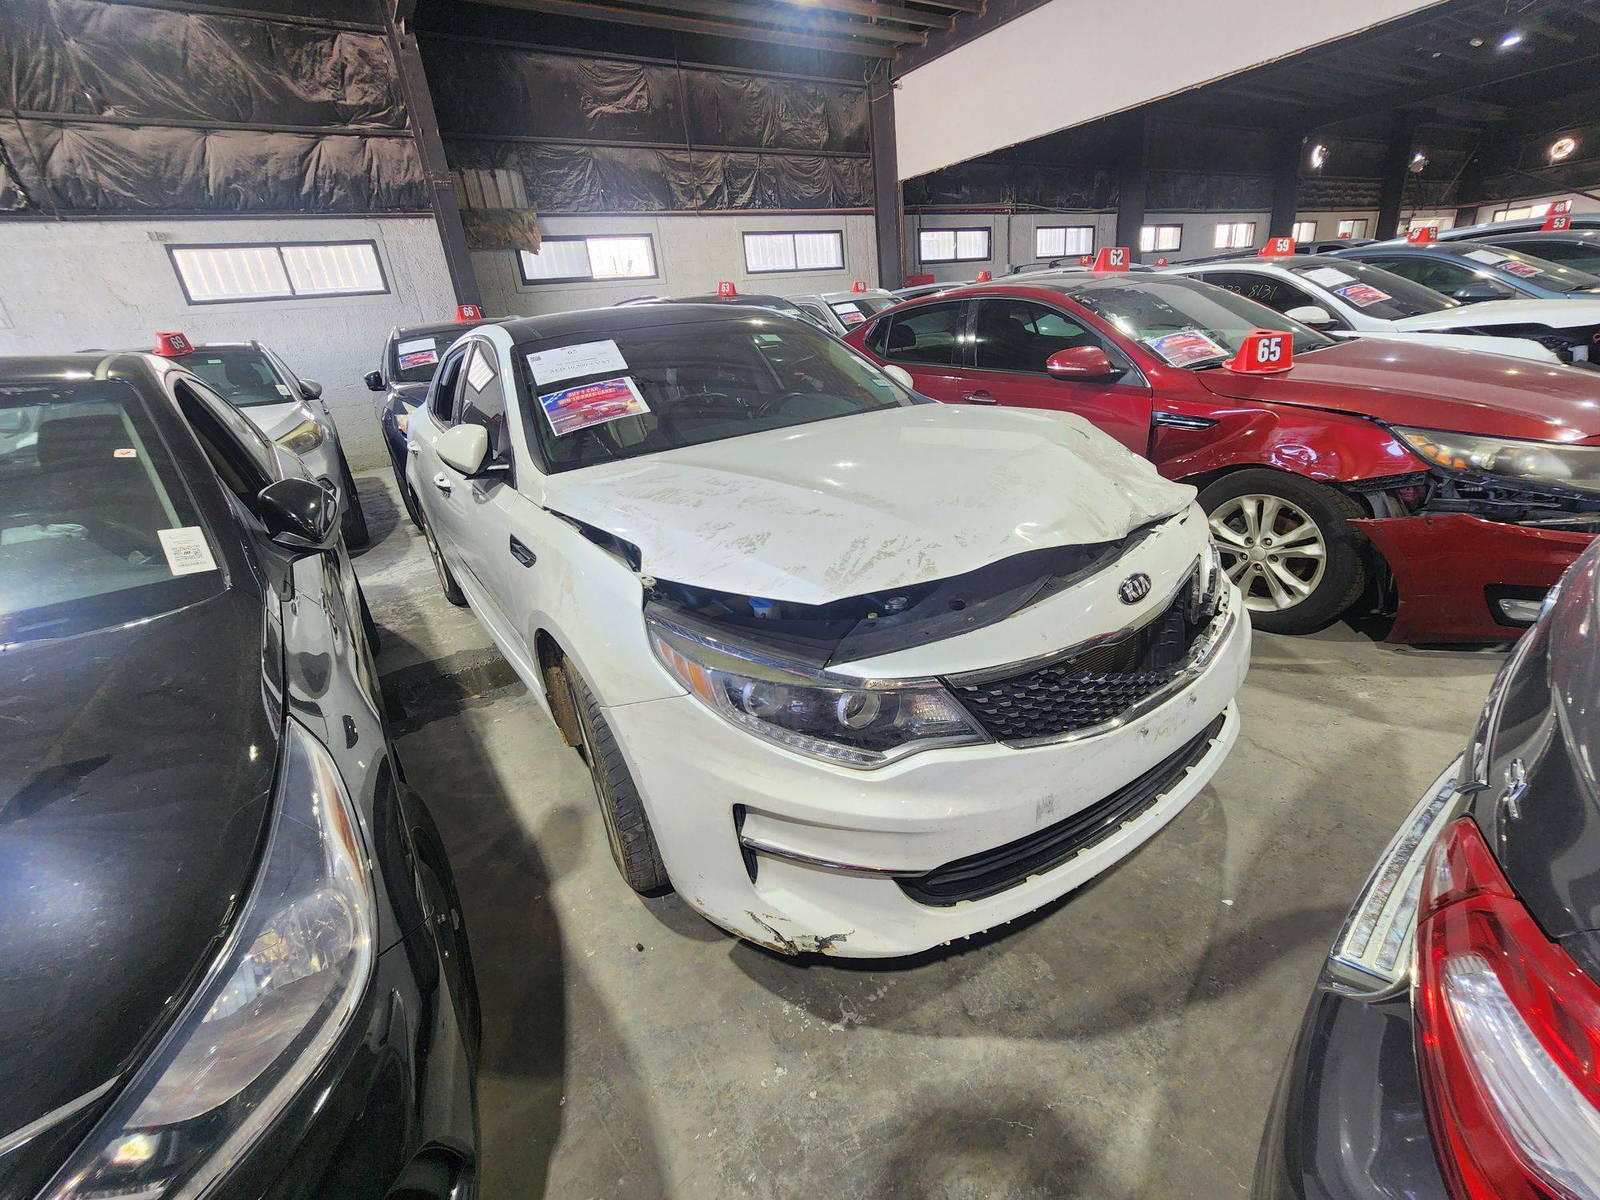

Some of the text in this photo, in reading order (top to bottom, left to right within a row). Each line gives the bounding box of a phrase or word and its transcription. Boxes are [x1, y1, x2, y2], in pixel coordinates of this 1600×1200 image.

[1553, 218, 1566, 228] 53
[1276, 239, 1289, 252] 59
[1110, 249, 1123, 266] 62
[721, 282, 730, 293] 63
[463, 306, 475, 317] 66
[170, 335, 186, 349] 69
[1256, 337, 1282, 363] 65
[1123, 575, 1150, 602] KIA
